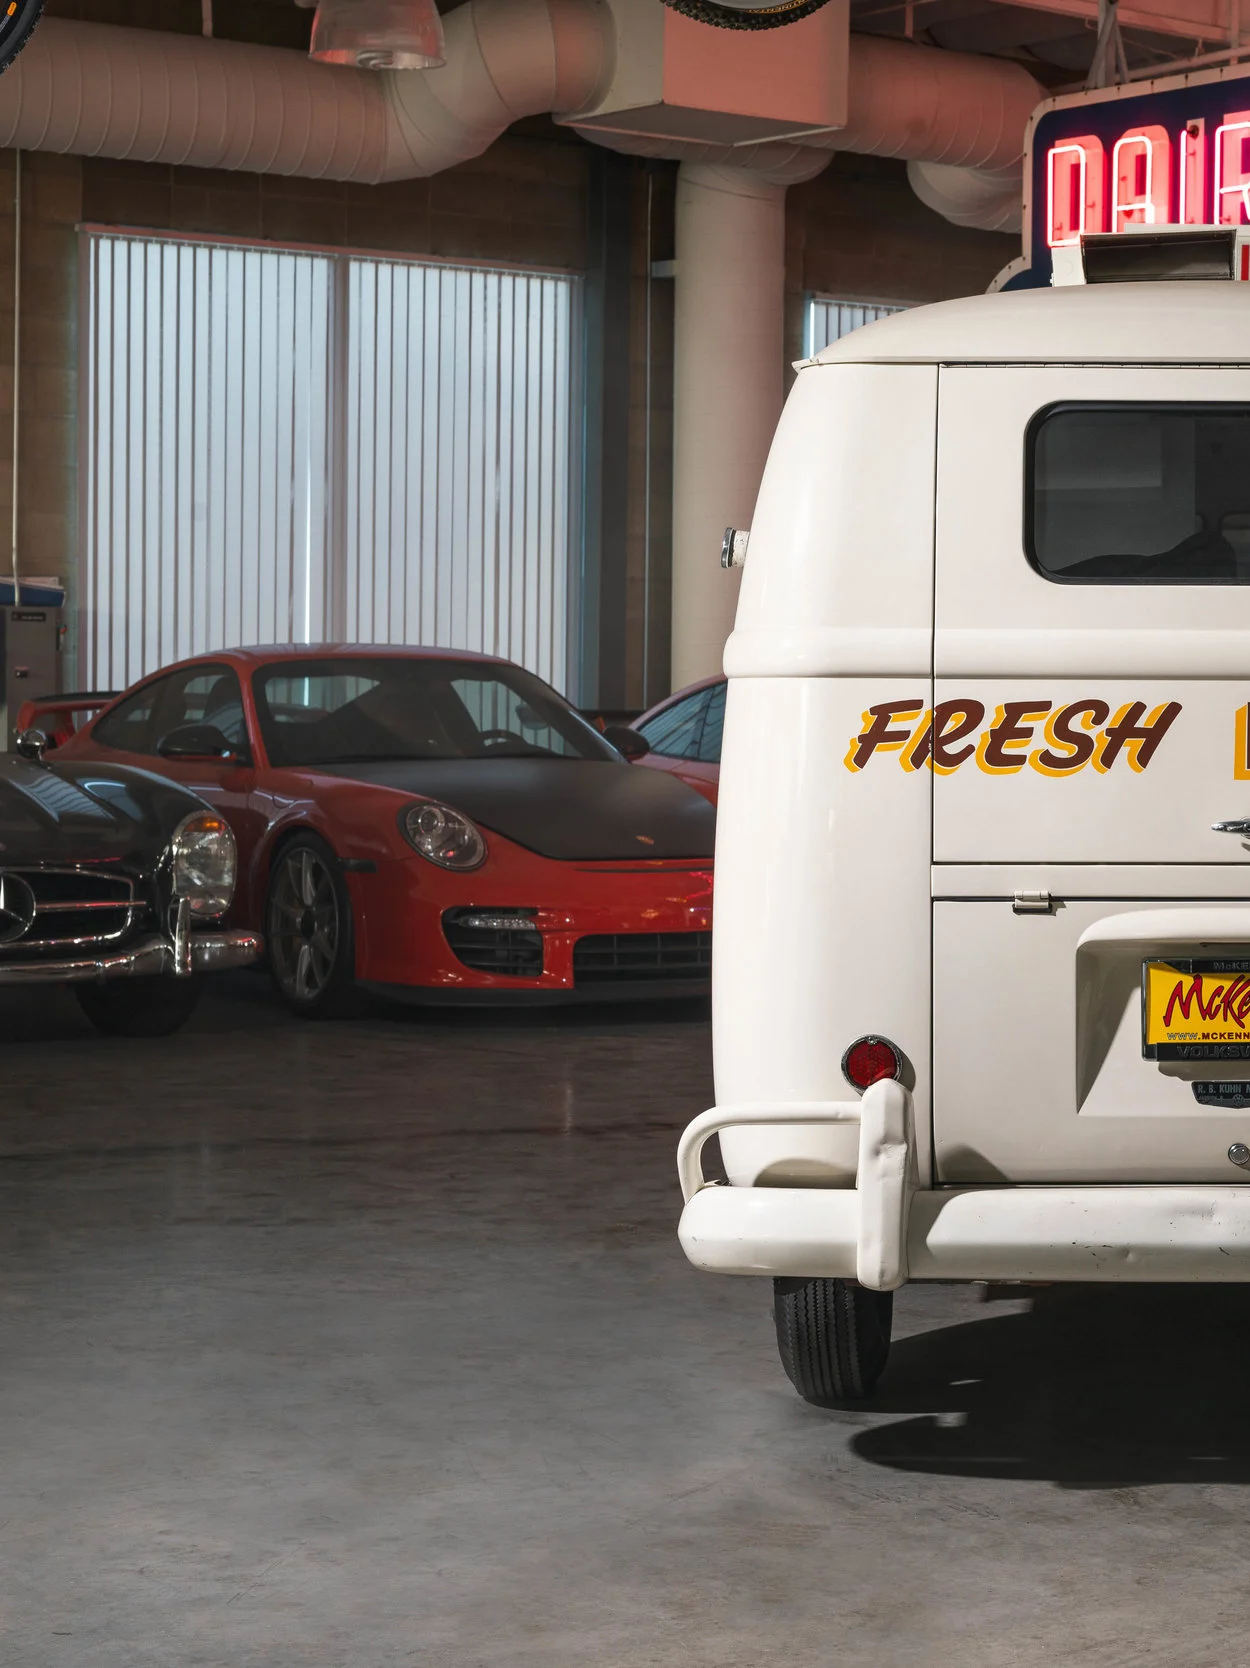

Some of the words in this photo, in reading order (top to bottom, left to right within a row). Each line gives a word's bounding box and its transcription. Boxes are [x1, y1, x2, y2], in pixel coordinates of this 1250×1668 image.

[844, 698, 1182, 776] FRESH
[1198, 1084, 1206, 1093] R.
[1208, 1084, 1216, 1093] B.
[1219, 1084, 1242, 1093] KUHN
